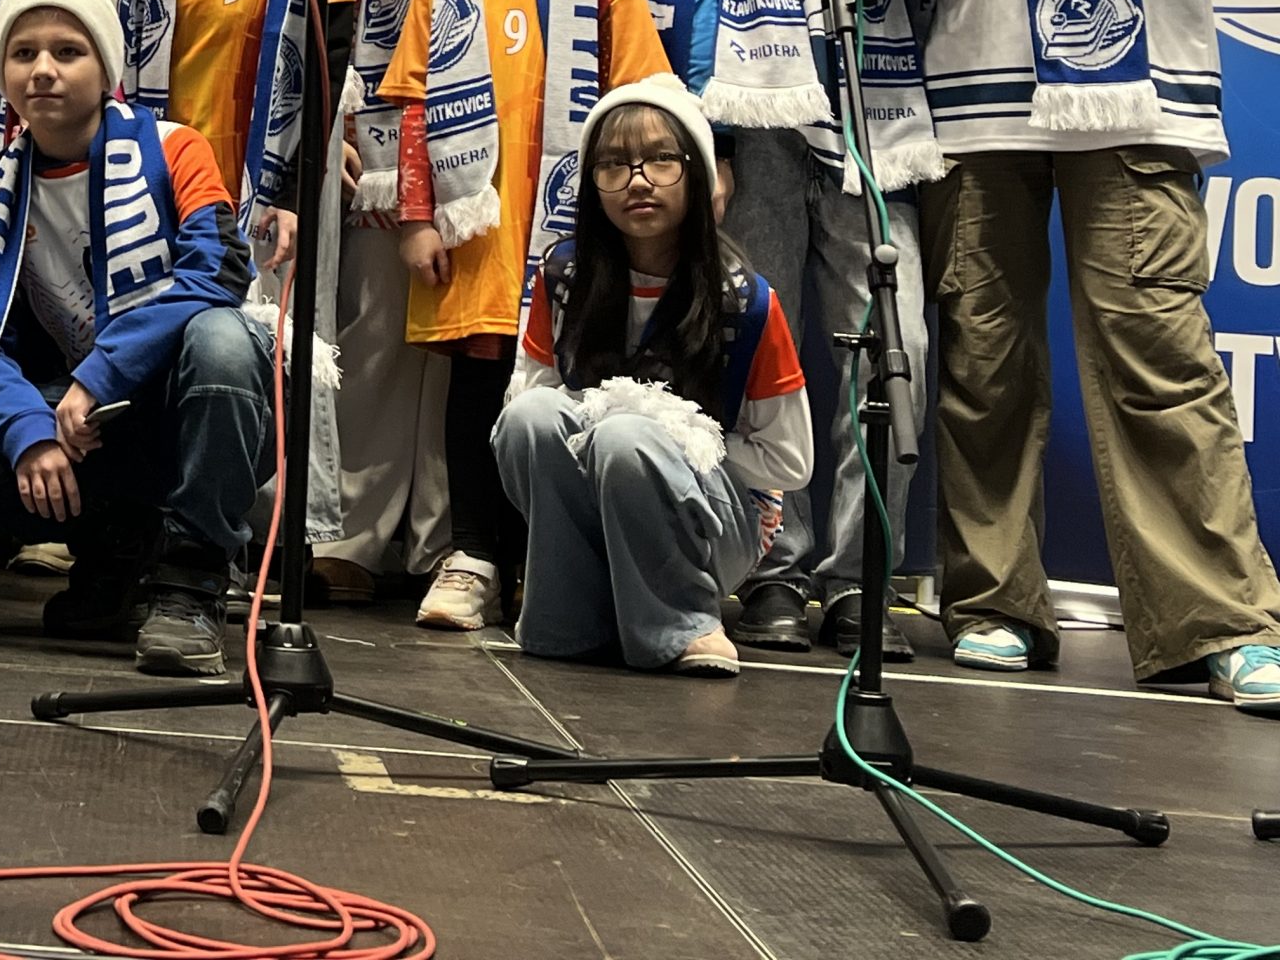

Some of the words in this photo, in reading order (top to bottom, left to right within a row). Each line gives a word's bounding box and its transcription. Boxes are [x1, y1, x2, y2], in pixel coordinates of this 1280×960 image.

[504, 8, 528, 56] 9
[749, 43, 800, 60] RIDERA
[425, 92, 492, 124] VITKOVICE
[436, 147, 489, 173] RIDERA
